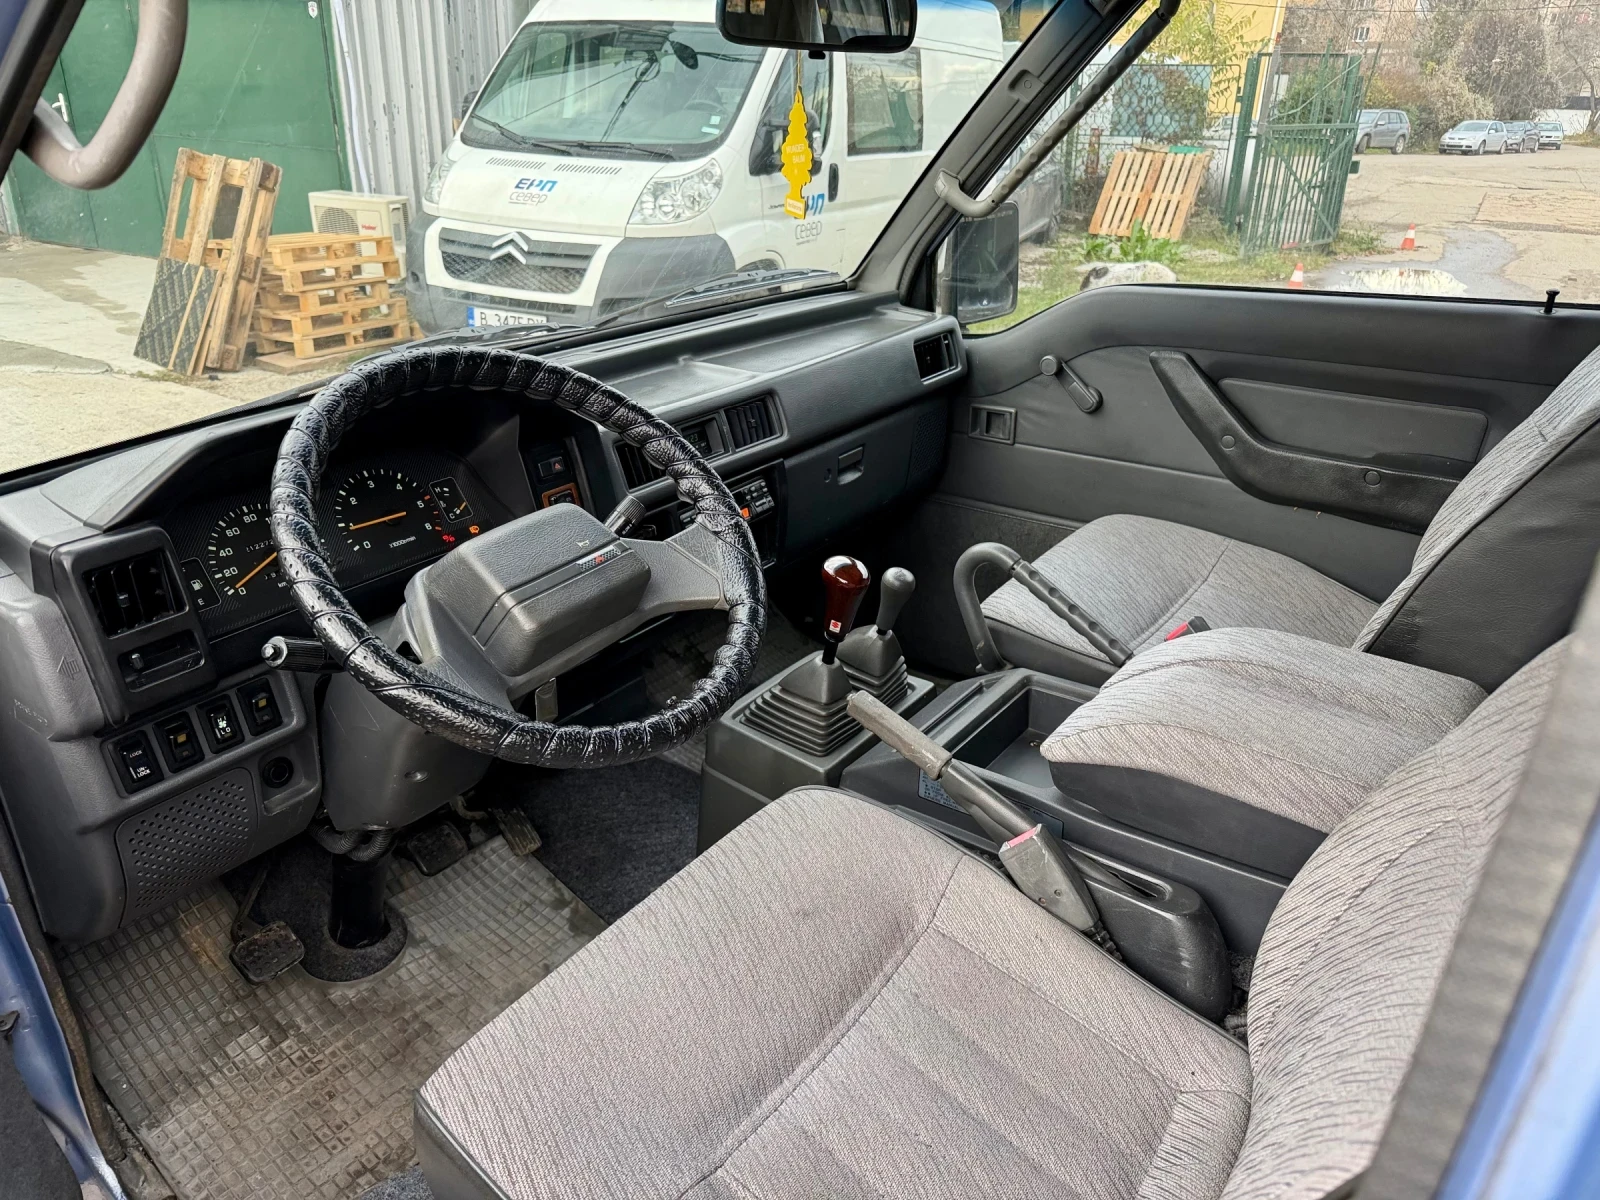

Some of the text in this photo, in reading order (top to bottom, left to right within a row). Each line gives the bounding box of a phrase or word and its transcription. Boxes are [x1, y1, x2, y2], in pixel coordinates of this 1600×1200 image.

[367, 480, 375, 489] 3
[396, 483, 403, 491] 4
[349, 496, 358, 506] 2
[416, 500, 425, 509] 5
[243, 513, 258, 524] 80
[225, 527, 241, 538] 60
[362, 540, 372, 549] 0
[219, 547, 234, 558] 40
[223, 566, 239, 578] 20
[238, 586, 247, 596] 0
[137, 769, 151, 778] LOCK
